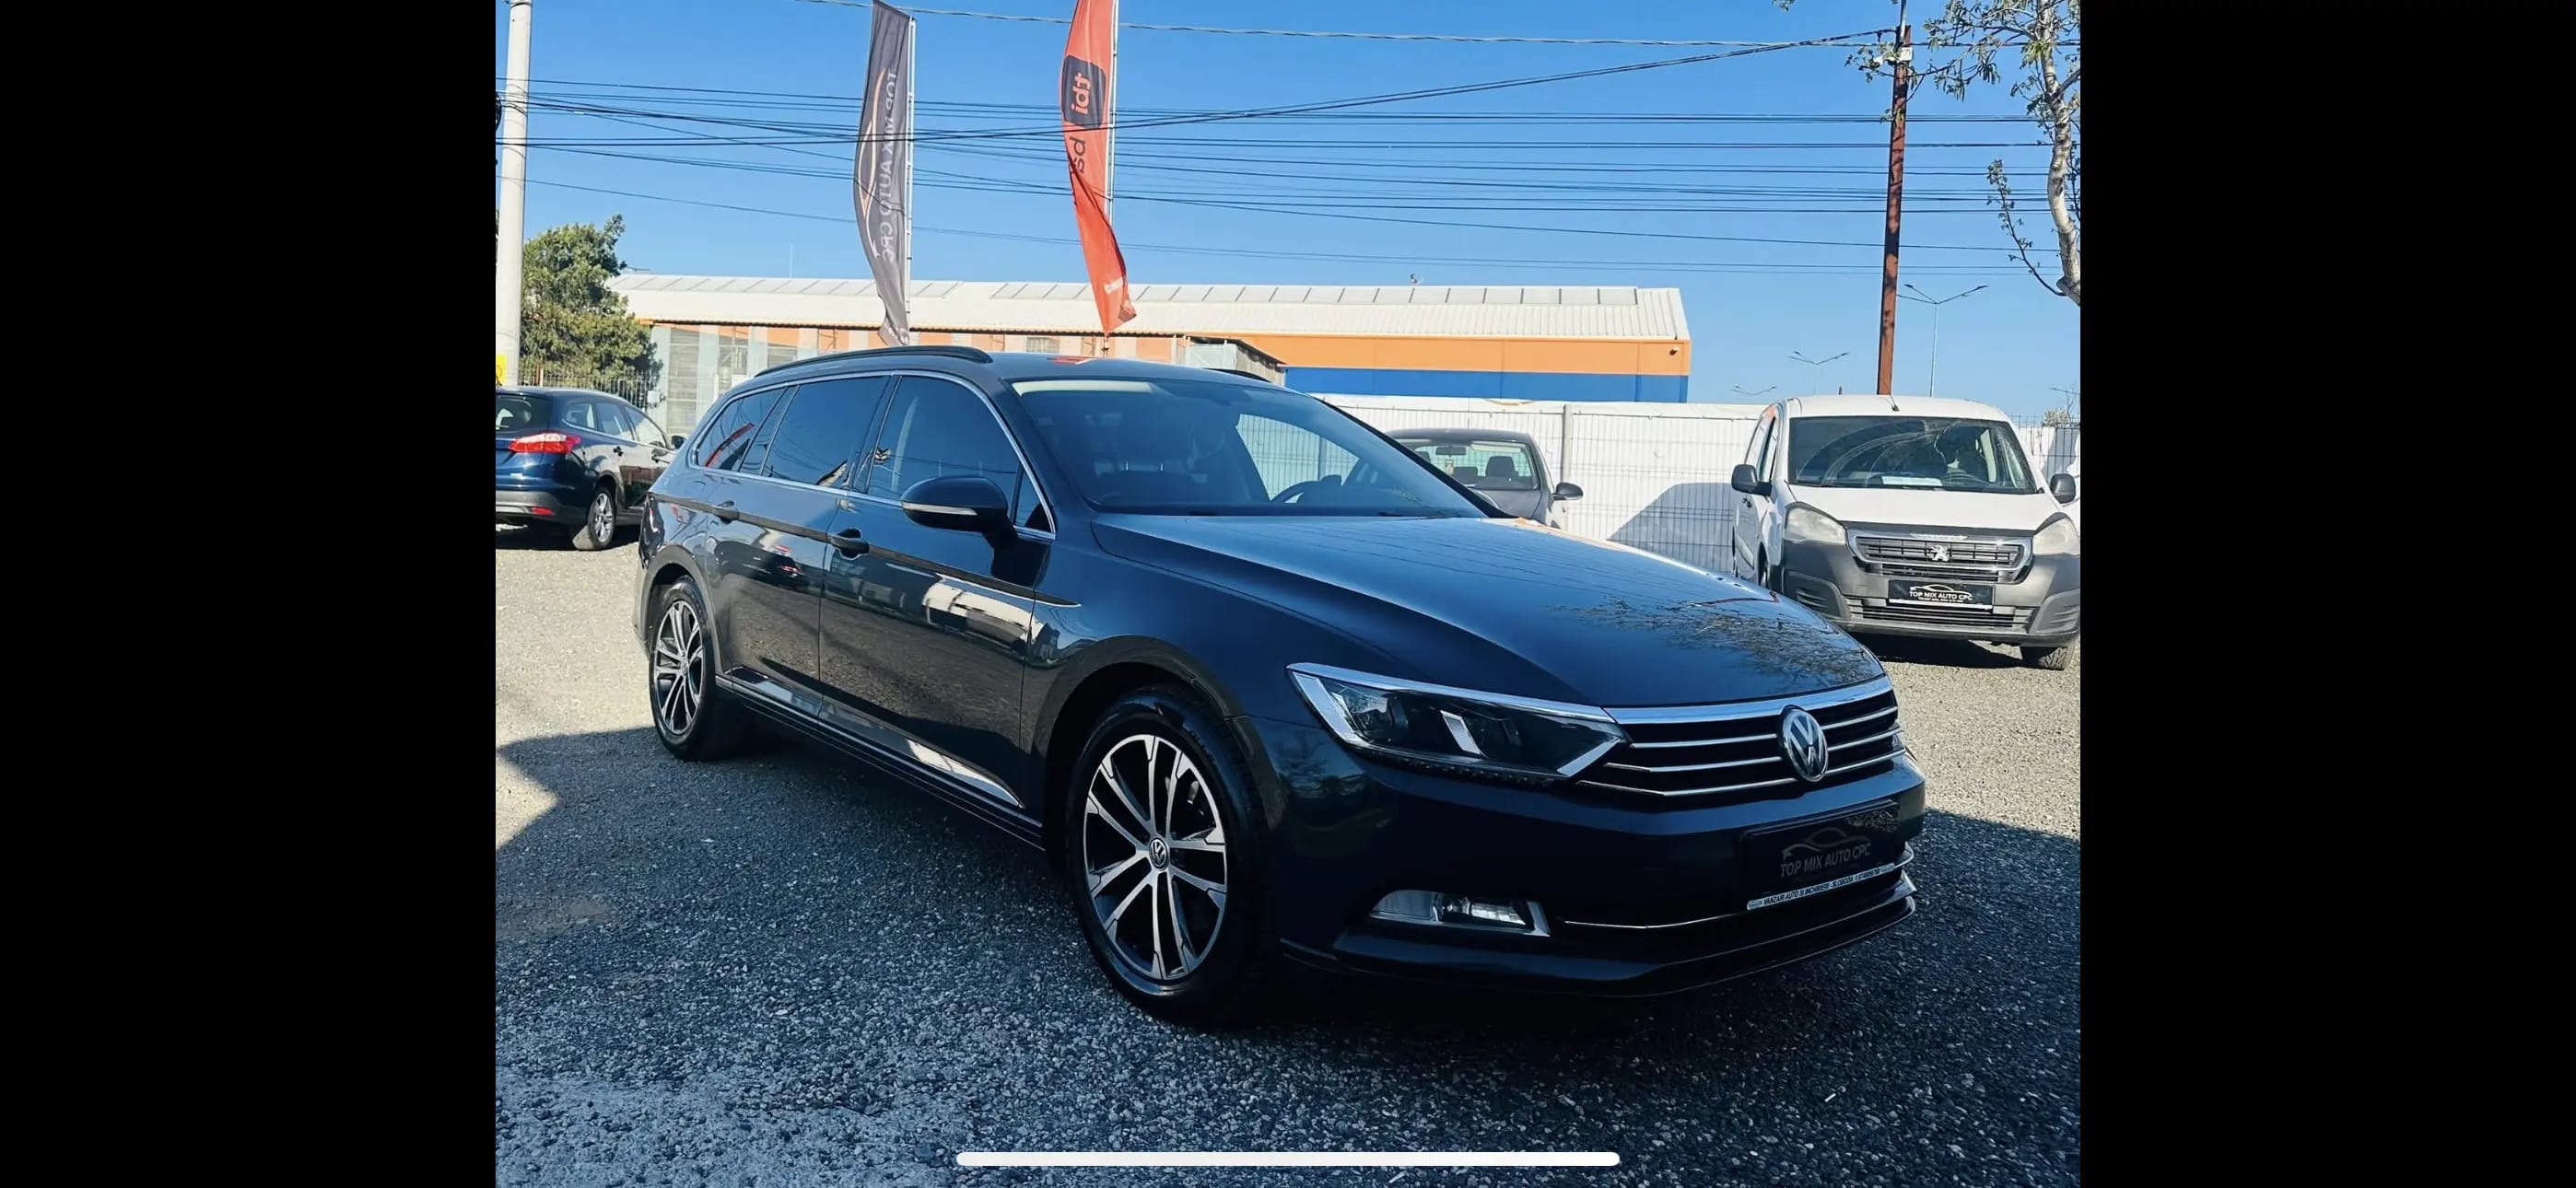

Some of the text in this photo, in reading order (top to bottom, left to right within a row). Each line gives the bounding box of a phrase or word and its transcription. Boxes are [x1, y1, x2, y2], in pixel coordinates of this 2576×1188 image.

[1780, 843, 1871, 877] TOP MIX AUTO CPC
[1786, 891, 1798, 901] AUTO
